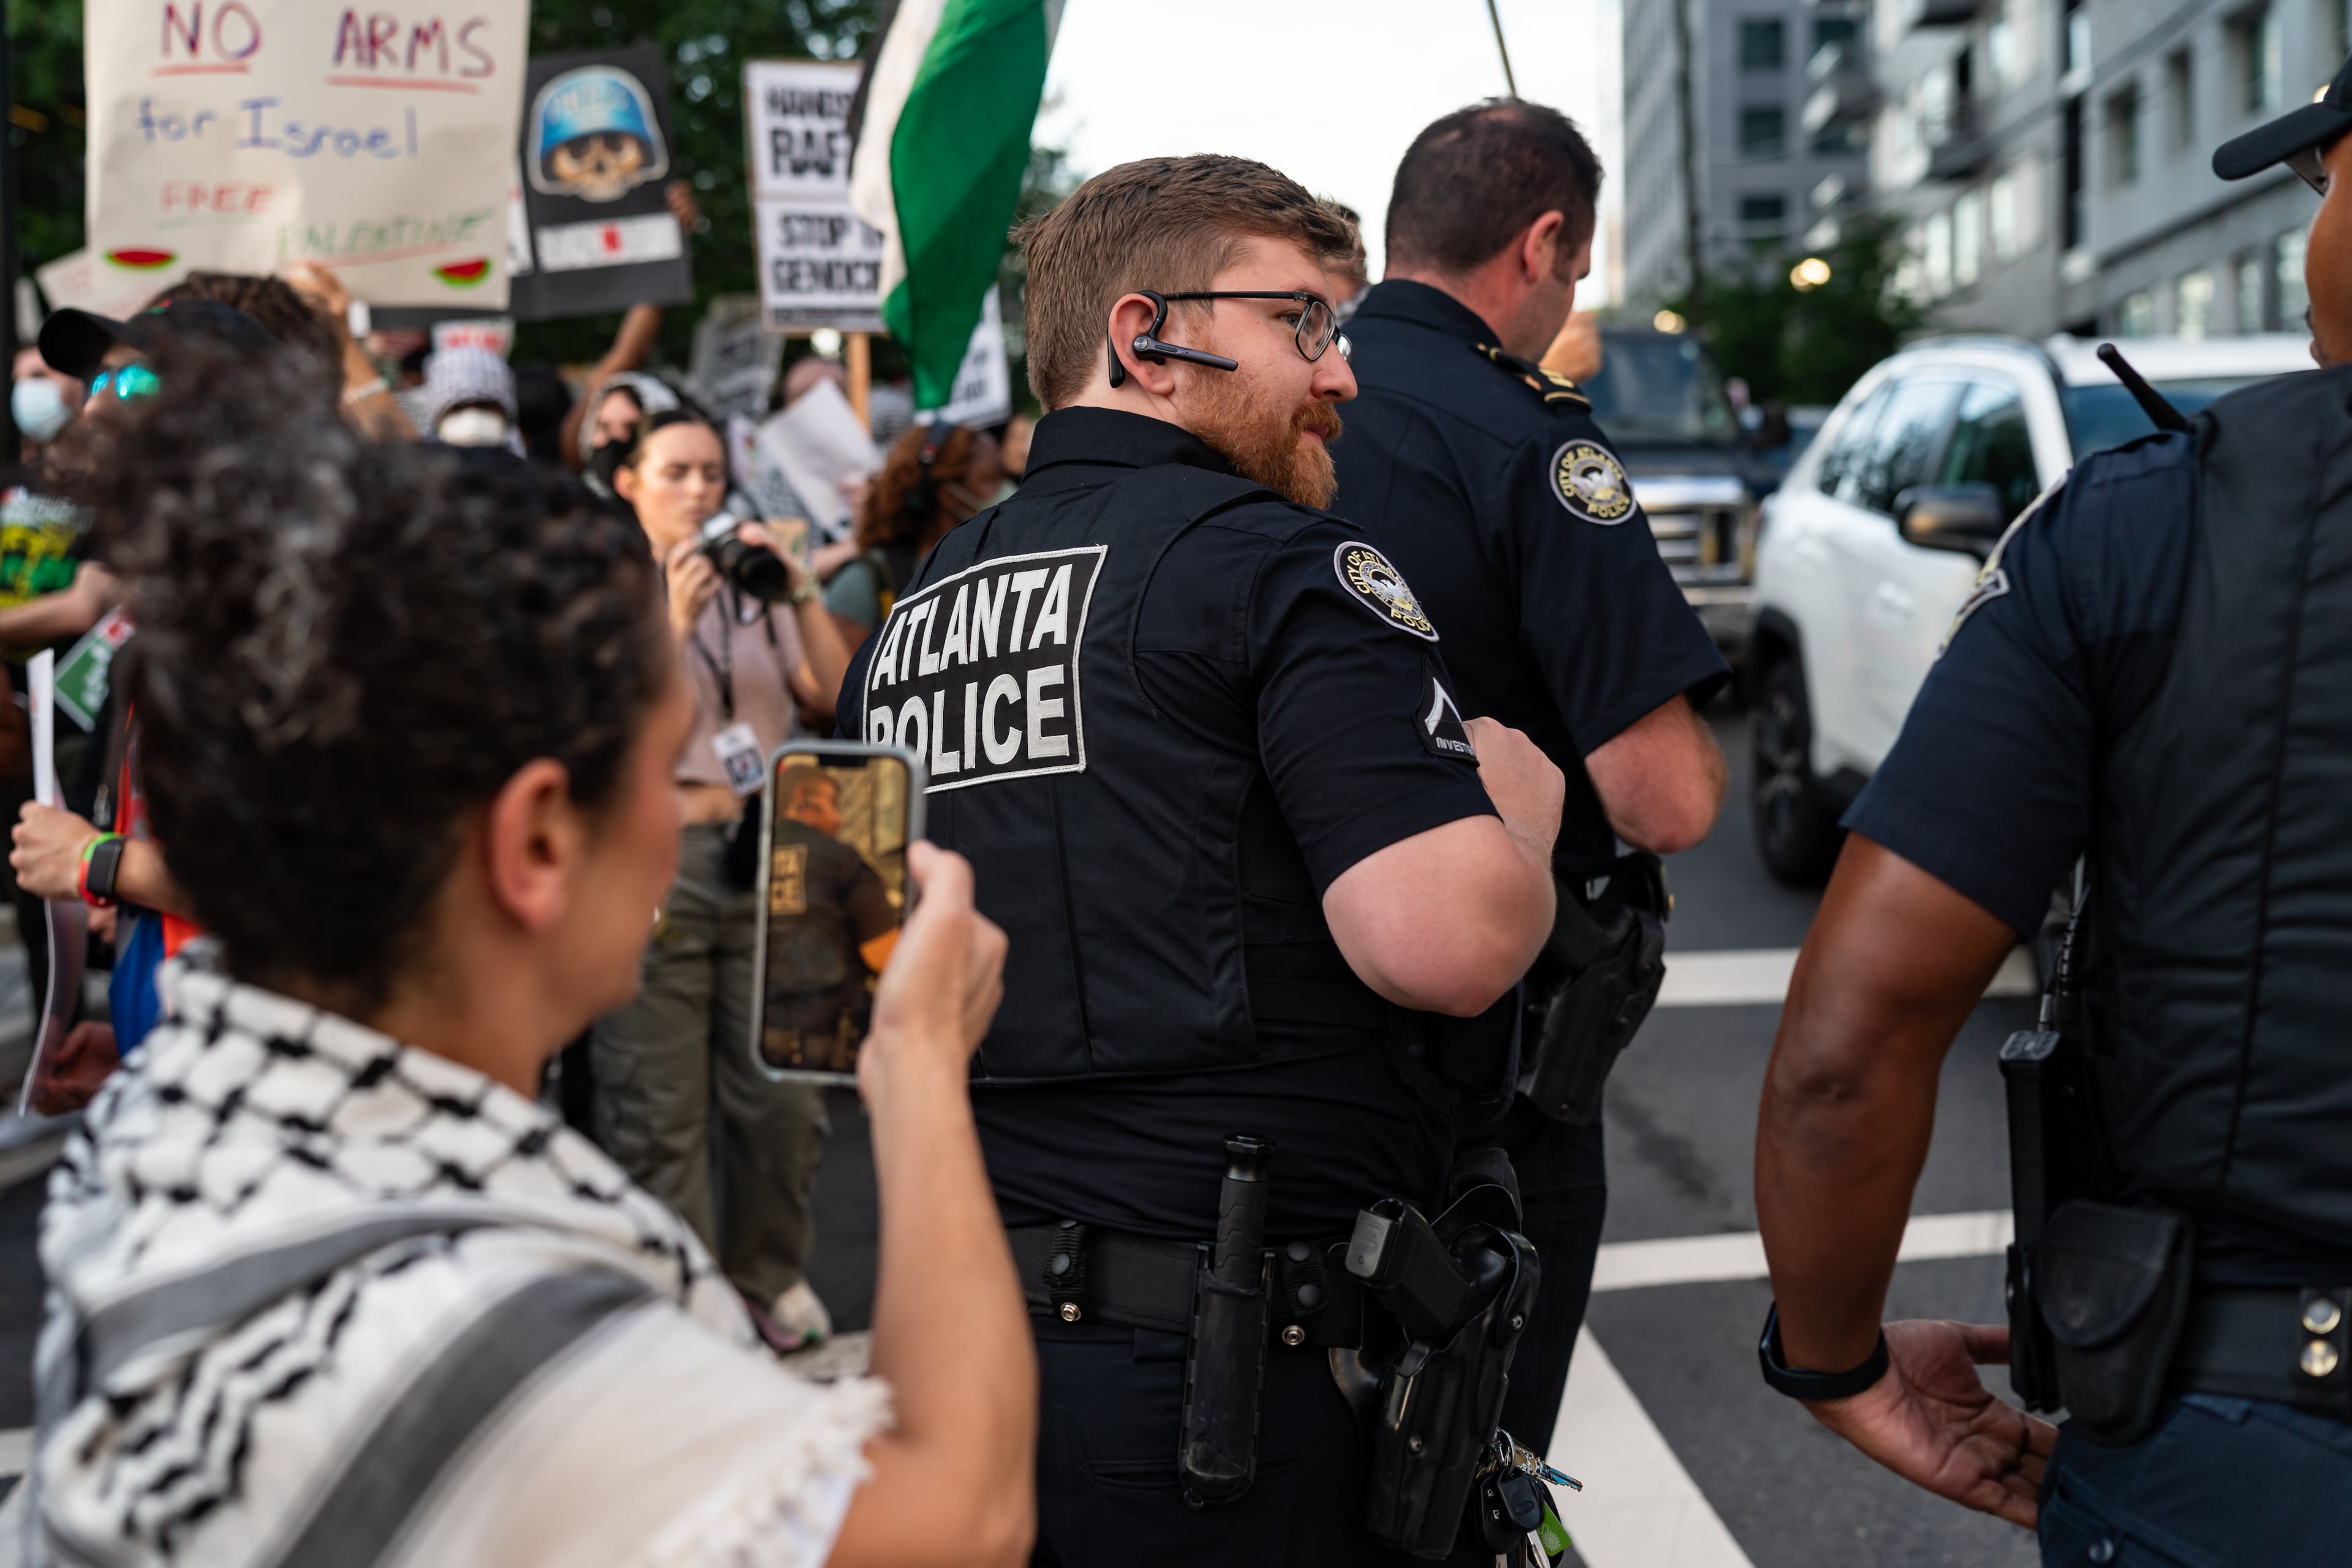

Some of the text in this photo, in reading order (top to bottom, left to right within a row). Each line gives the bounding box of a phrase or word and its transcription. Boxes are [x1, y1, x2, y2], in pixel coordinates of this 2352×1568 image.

[162, 0, 496, 78] NO ARMS
[136, 96, 418, 159] for Israel
[160, 180, 274, 214] FREE
[277, 205, 497, 258] PALESTINE
[780, 216, 850, 247] STOP
[1561, 450, 1575, 469] OF
[1559, 469, 1575, 497] CITY
[1587, 492, 1630, 518] POLICE
[1348, 551, 1362, 566] OF
[1347, 565, 1371, 594] CITY
[872, 564, 1073, 691] ATLANTA
[870, 664, 1069, 775] POLICE
